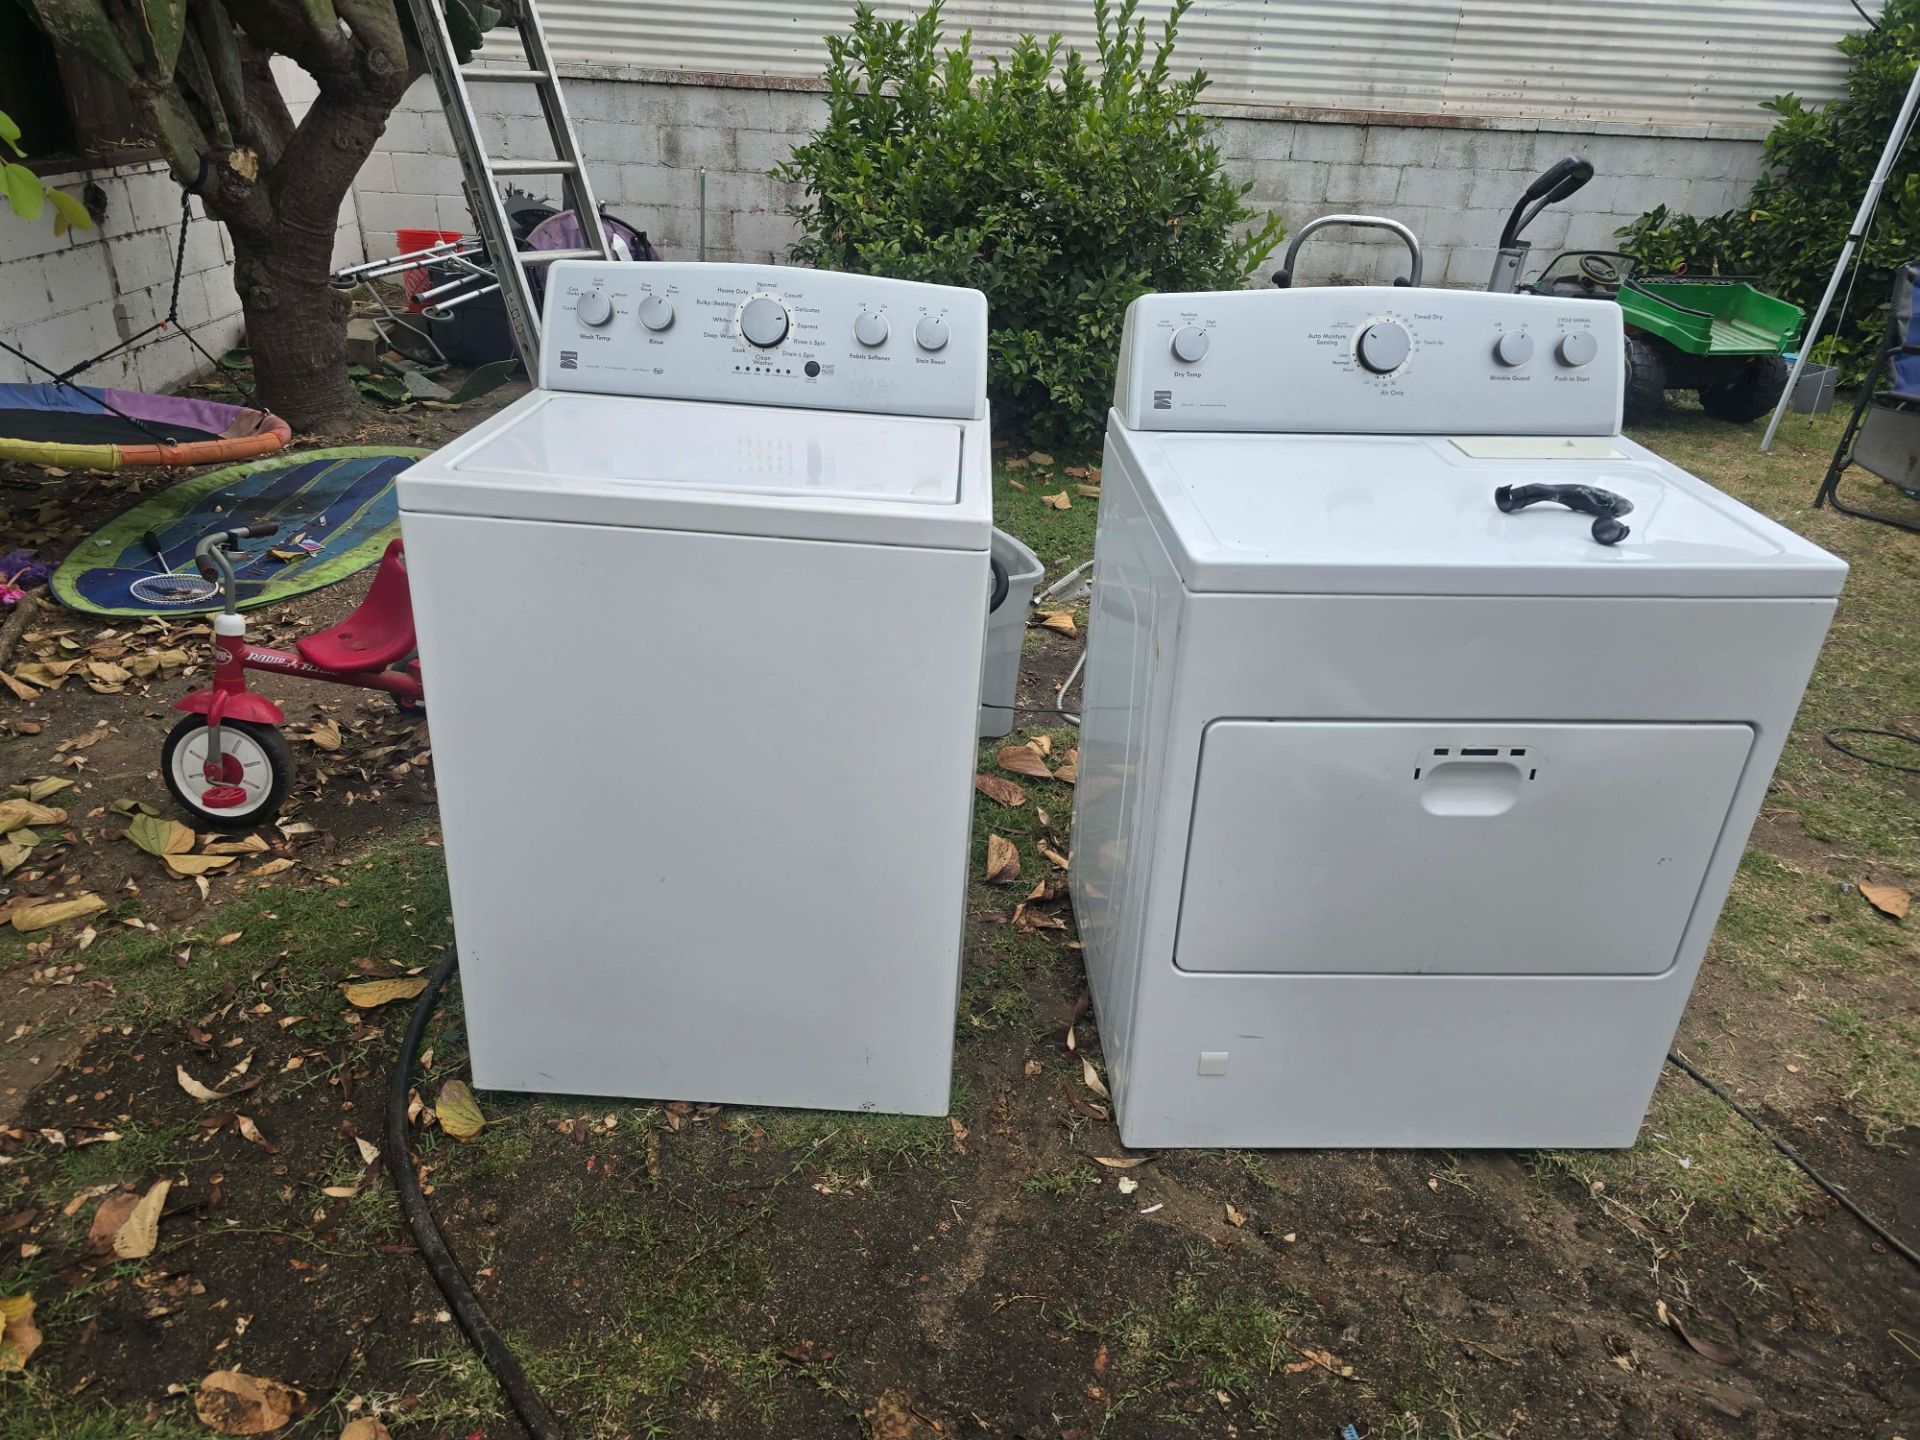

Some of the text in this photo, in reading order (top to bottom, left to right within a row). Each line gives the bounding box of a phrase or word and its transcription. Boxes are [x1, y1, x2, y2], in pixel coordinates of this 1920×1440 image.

[713, 300, 737, 308] Bedding
[795, 306, 820, 314] Delicates
[1186, 371, 1202, 379] Temp
[246, 652, 286, 664] RADIO
